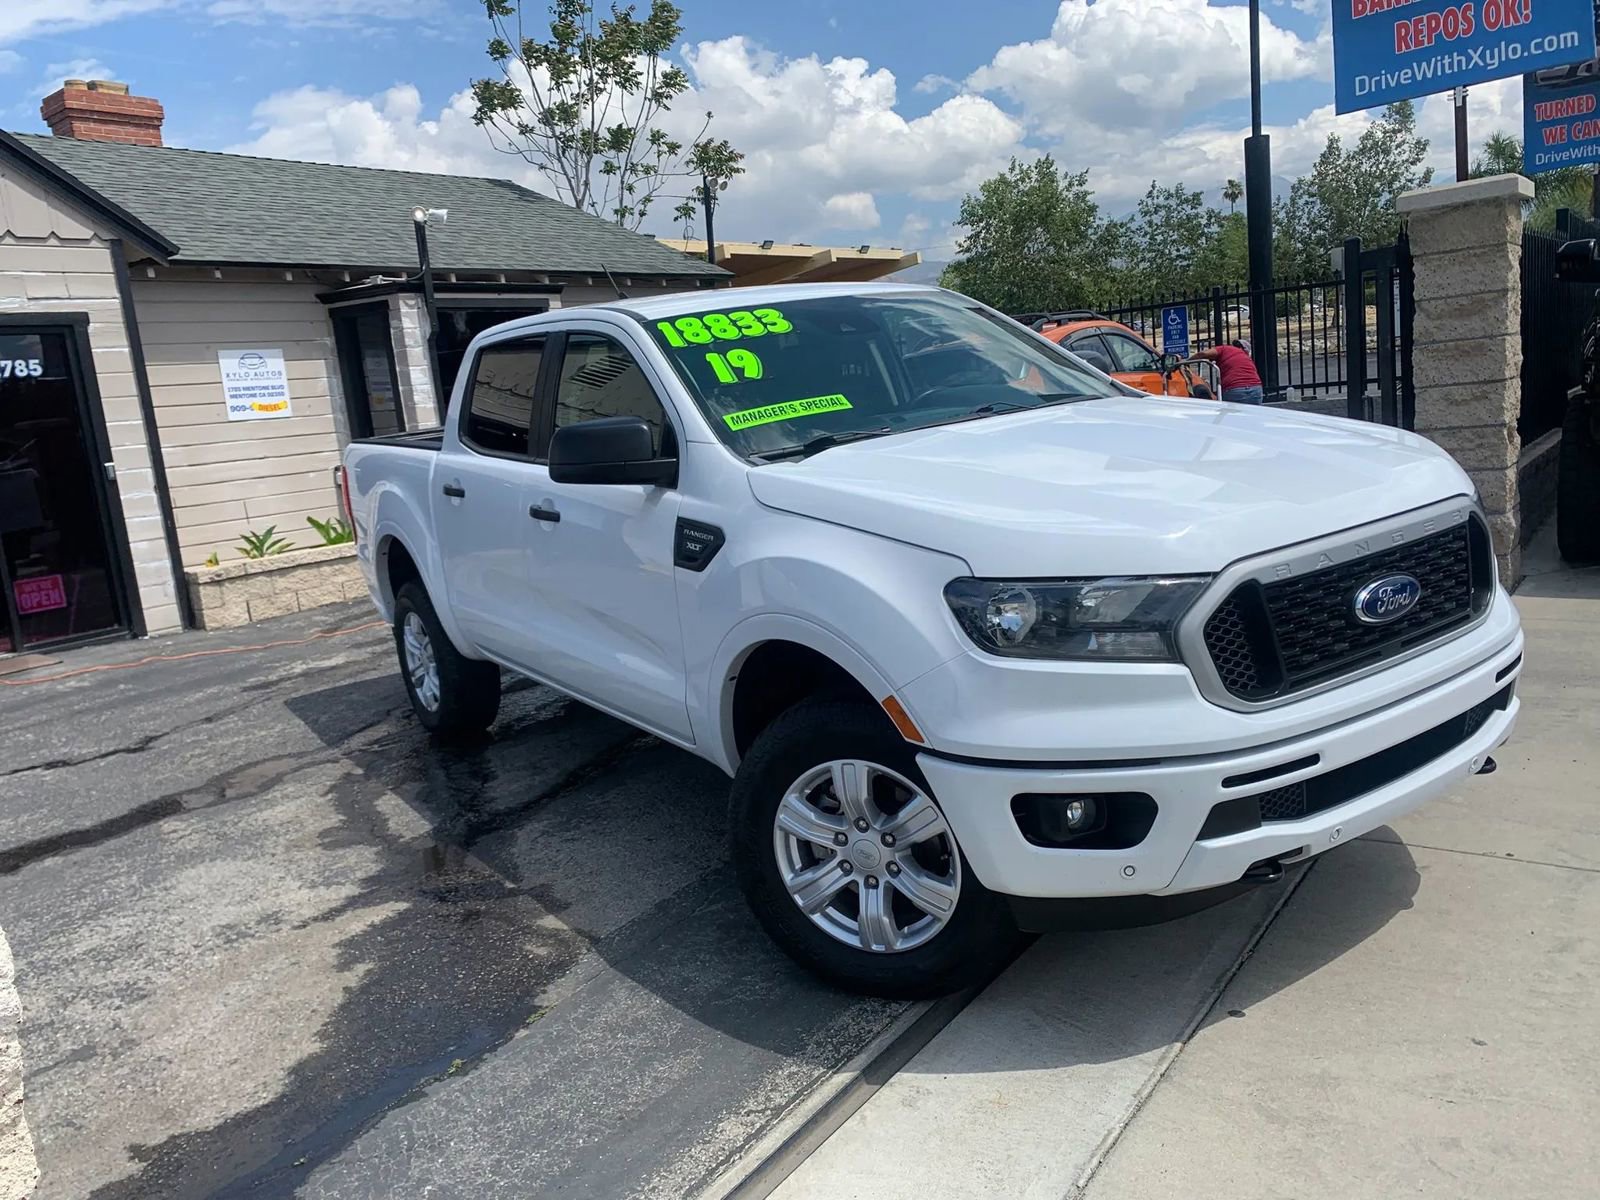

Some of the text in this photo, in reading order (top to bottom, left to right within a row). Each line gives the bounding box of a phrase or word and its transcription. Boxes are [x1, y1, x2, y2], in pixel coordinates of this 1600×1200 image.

[1394, 3, 1476, 54] REPOS
[1482, 0, 1533, 32] OK!
[1354, 31, 1579, 97] DriveWithXylo.com
[1534, 94, 1597, 122] TURNED
[1543, 124, 1568, 146] WE
[657, 308, 794, 348] 18833
[0, 359, 43, 378] 785
[705, 348, 764, 384] 19
[730, 396, 848, 426] MANAGER'S SPECIAL
[683, 529, 714, 541] RANGER
[686, 542, 702, 550] XLT
[1272, 510, 1465, 580] RANGER
[20, 588, 62, 609] OPEN
[1377, 580, 1413, 614] Ford
